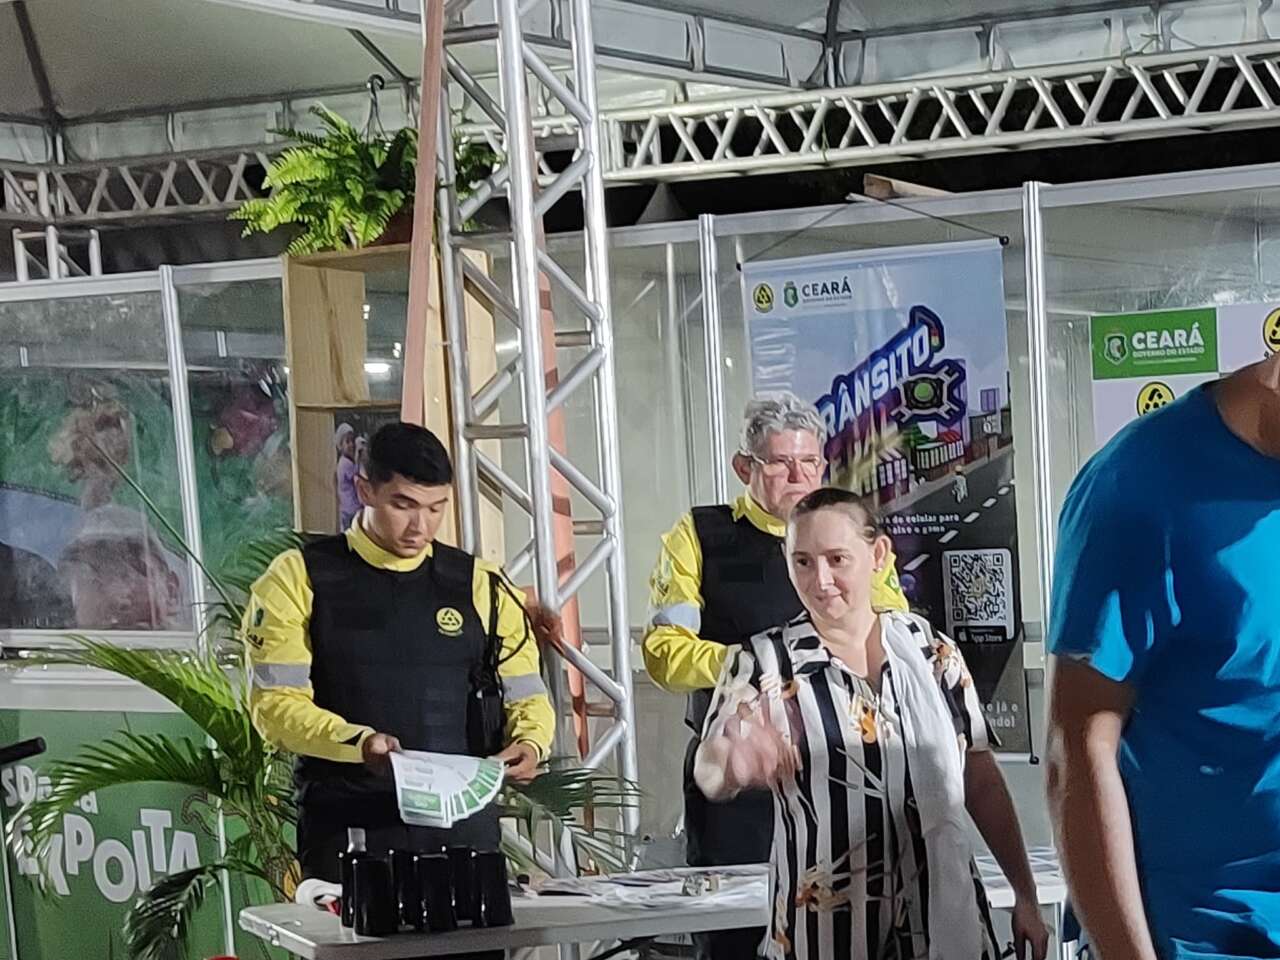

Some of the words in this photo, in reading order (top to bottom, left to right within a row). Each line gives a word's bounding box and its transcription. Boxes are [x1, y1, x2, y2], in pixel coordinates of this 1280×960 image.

[801, 276, 852, 297] CEARÁ
[1132, 321, 1205, 350] CEARÁ
[818, 323, 930, 438] RÂNSITO
